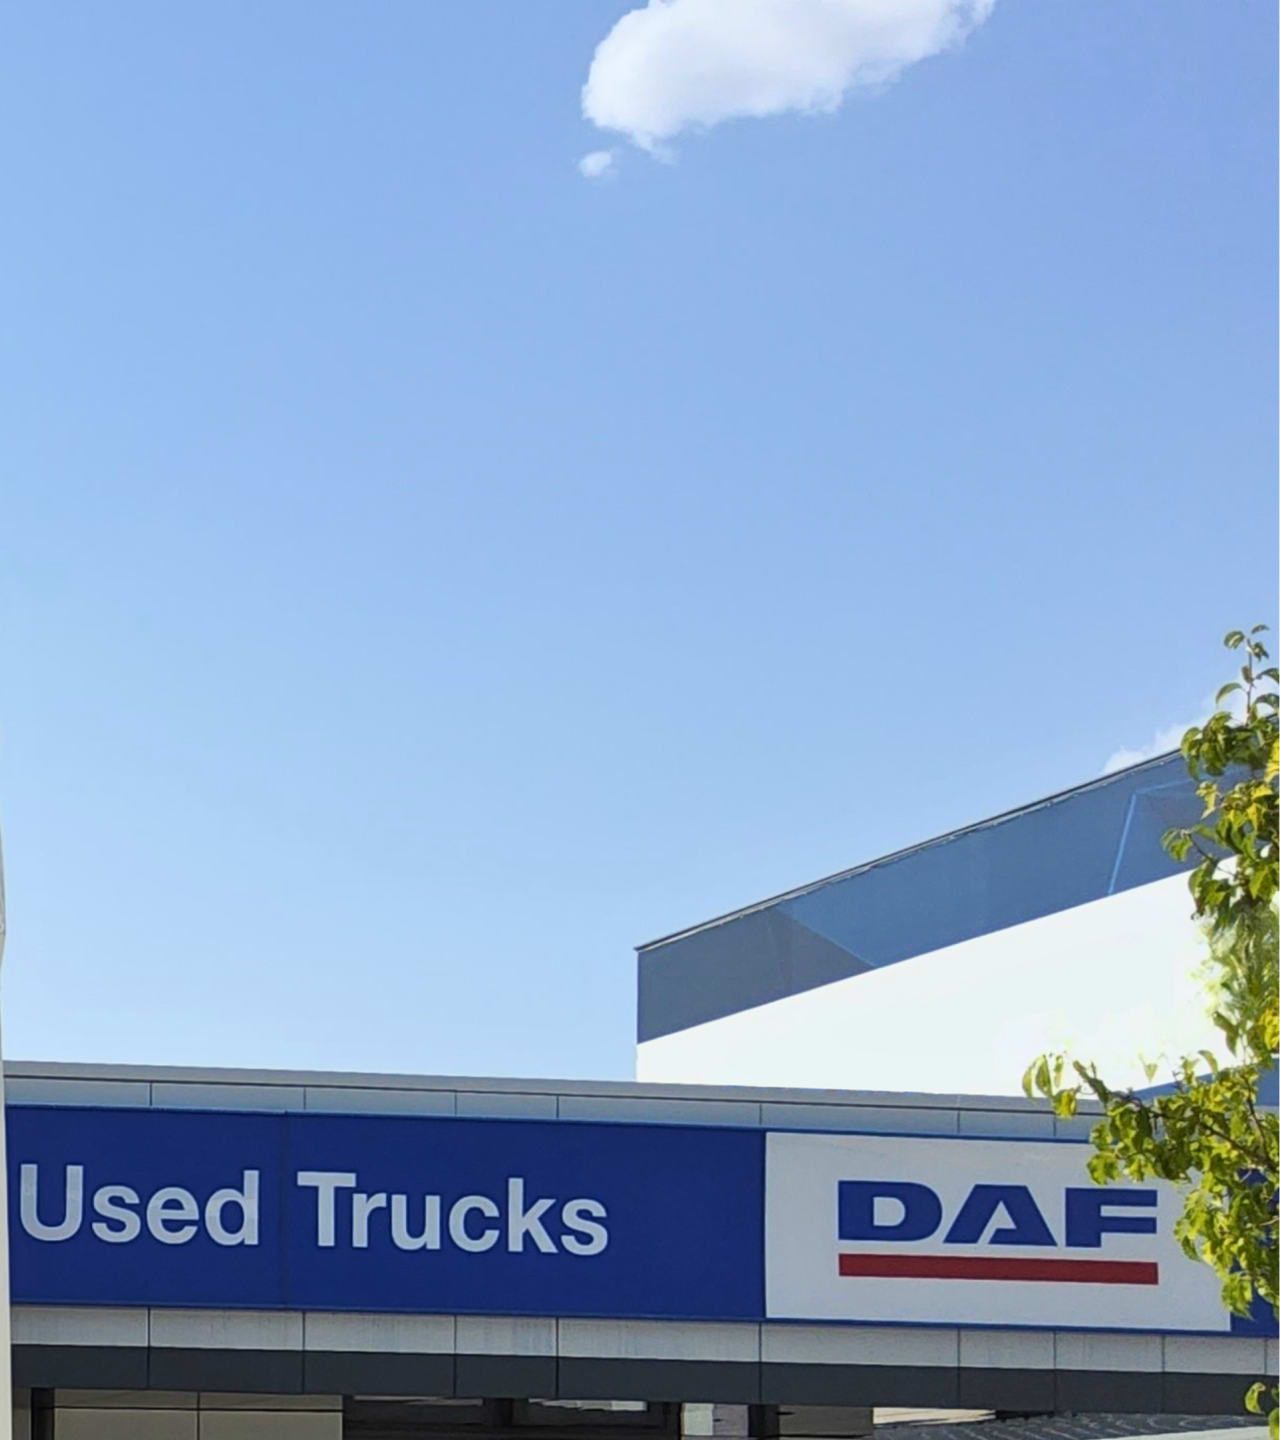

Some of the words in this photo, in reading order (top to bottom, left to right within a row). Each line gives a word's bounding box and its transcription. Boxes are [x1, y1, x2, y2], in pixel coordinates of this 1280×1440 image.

[19, 1163, 260, 1246] Used
[297, 1171, 609, 1256] Trucks
[837, 1180, 1158, 1248] DAF
